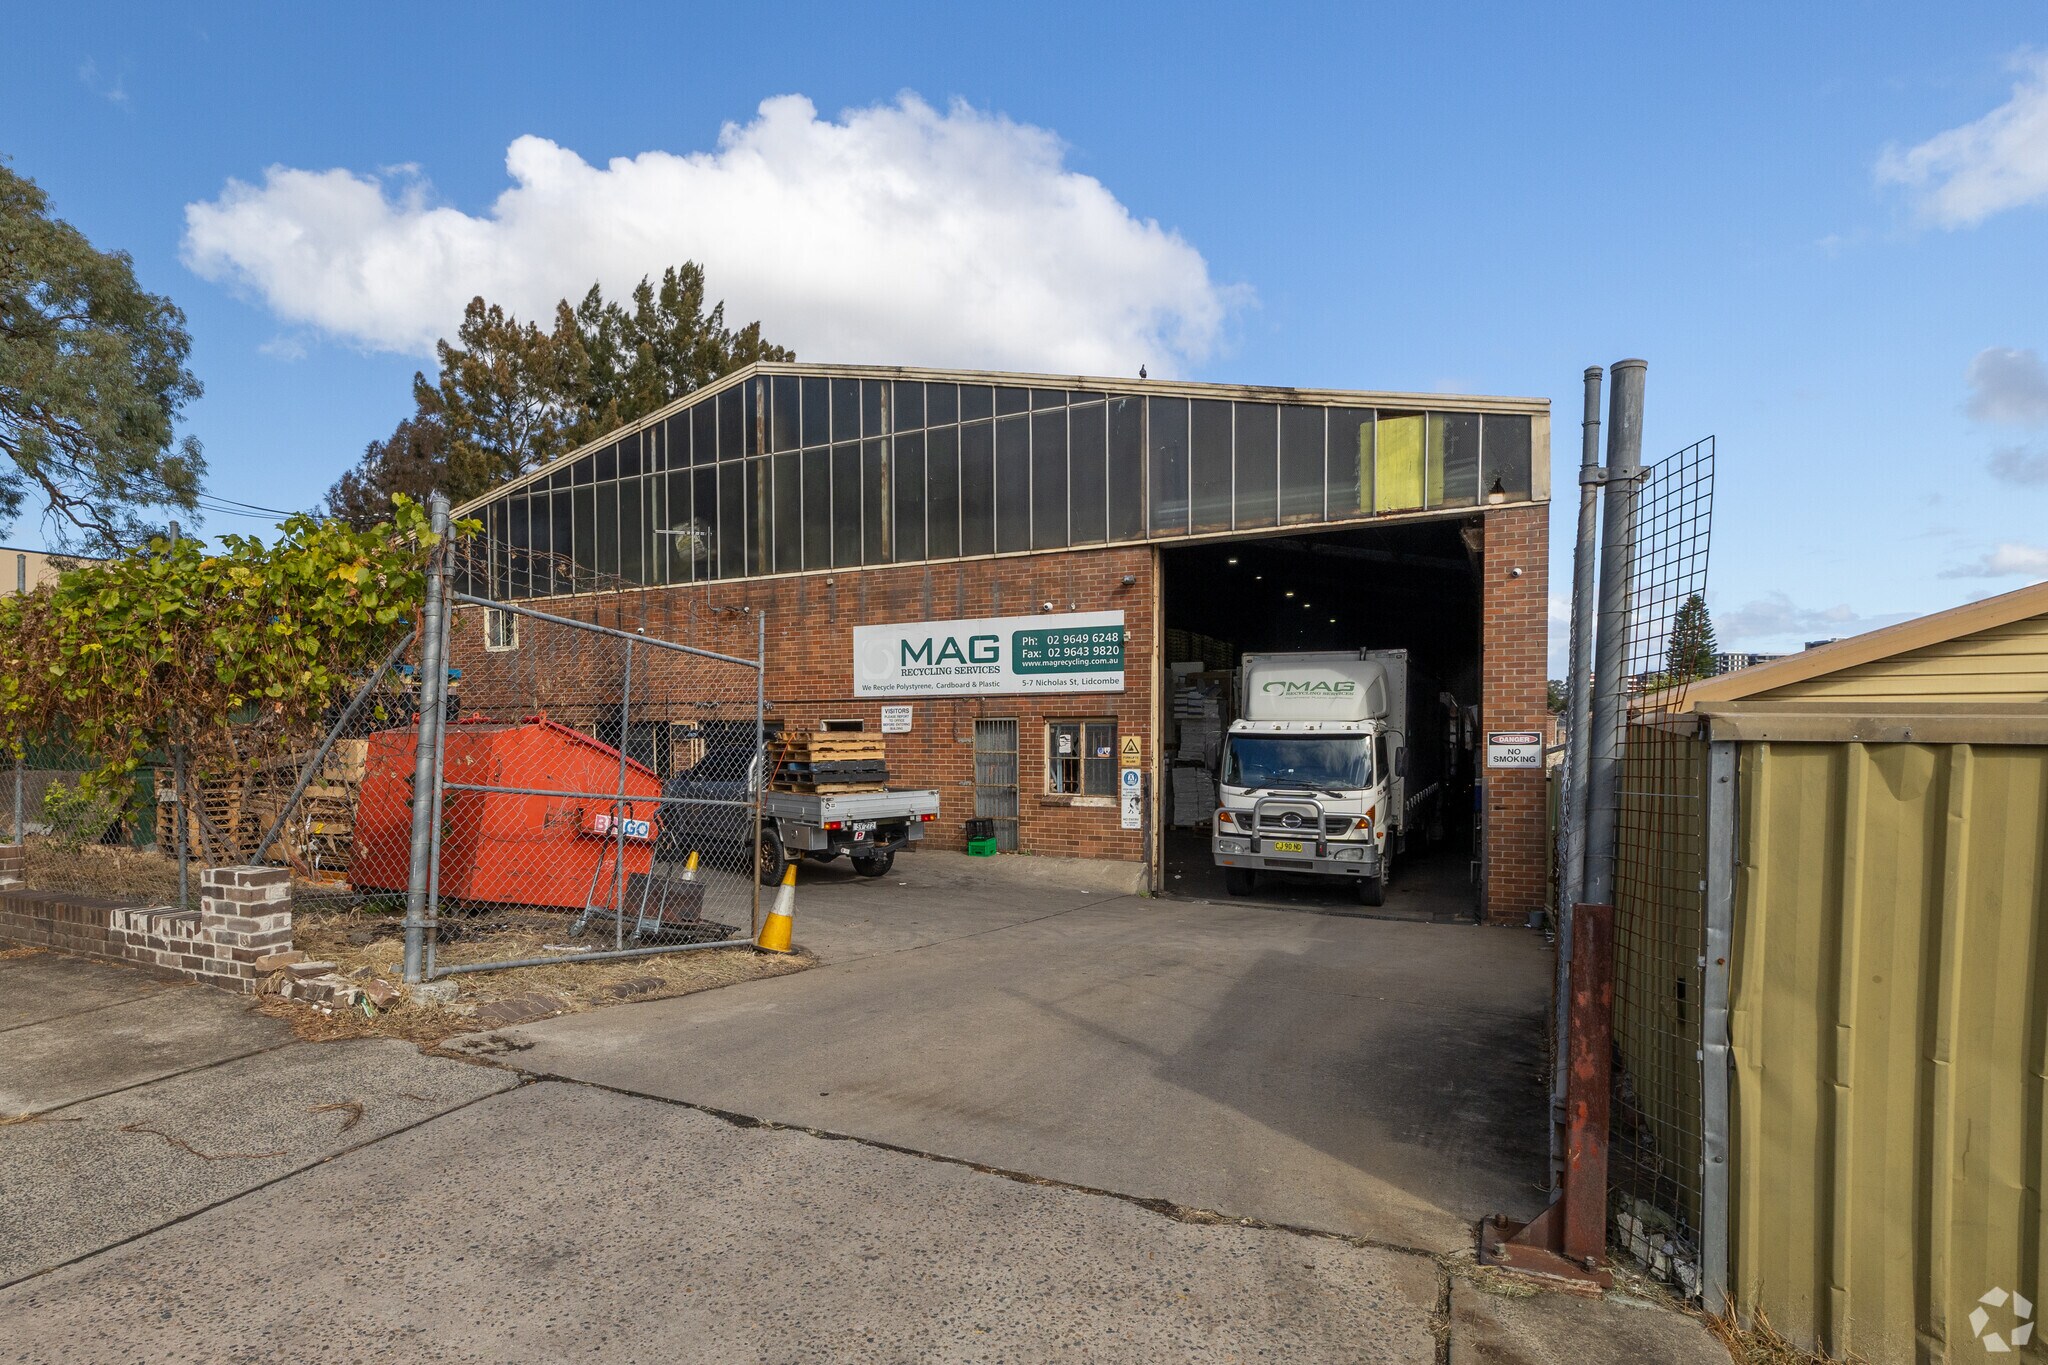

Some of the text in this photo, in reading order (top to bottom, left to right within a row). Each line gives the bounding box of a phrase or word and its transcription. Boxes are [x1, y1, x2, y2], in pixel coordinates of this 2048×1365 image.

[1022, 632, 1119, 646] Ph: 02 9649 6248
[901, 634, 1000, 666] MAG
[1022, 645, 1120, 659] Fax: 02 9643 9820
[1022, 658, 1119, 668] www.magrecycling.com.au
[901, 665, 1000, 677] RECYCLING SERVICES
[873, 683, 895, 692] Recycle
[896, 682, 934, 691] Polystyrene,
[936, 681, 971, 689] Cardboard
[979, 680, 1000, 688] Plastic
[1022, 676, 1120, 687] 5-7 Nicholas St, Lidcombe
[1287, 681, 1355, 692] MAG
[1493, 755, 1536, 763] SMOKING
